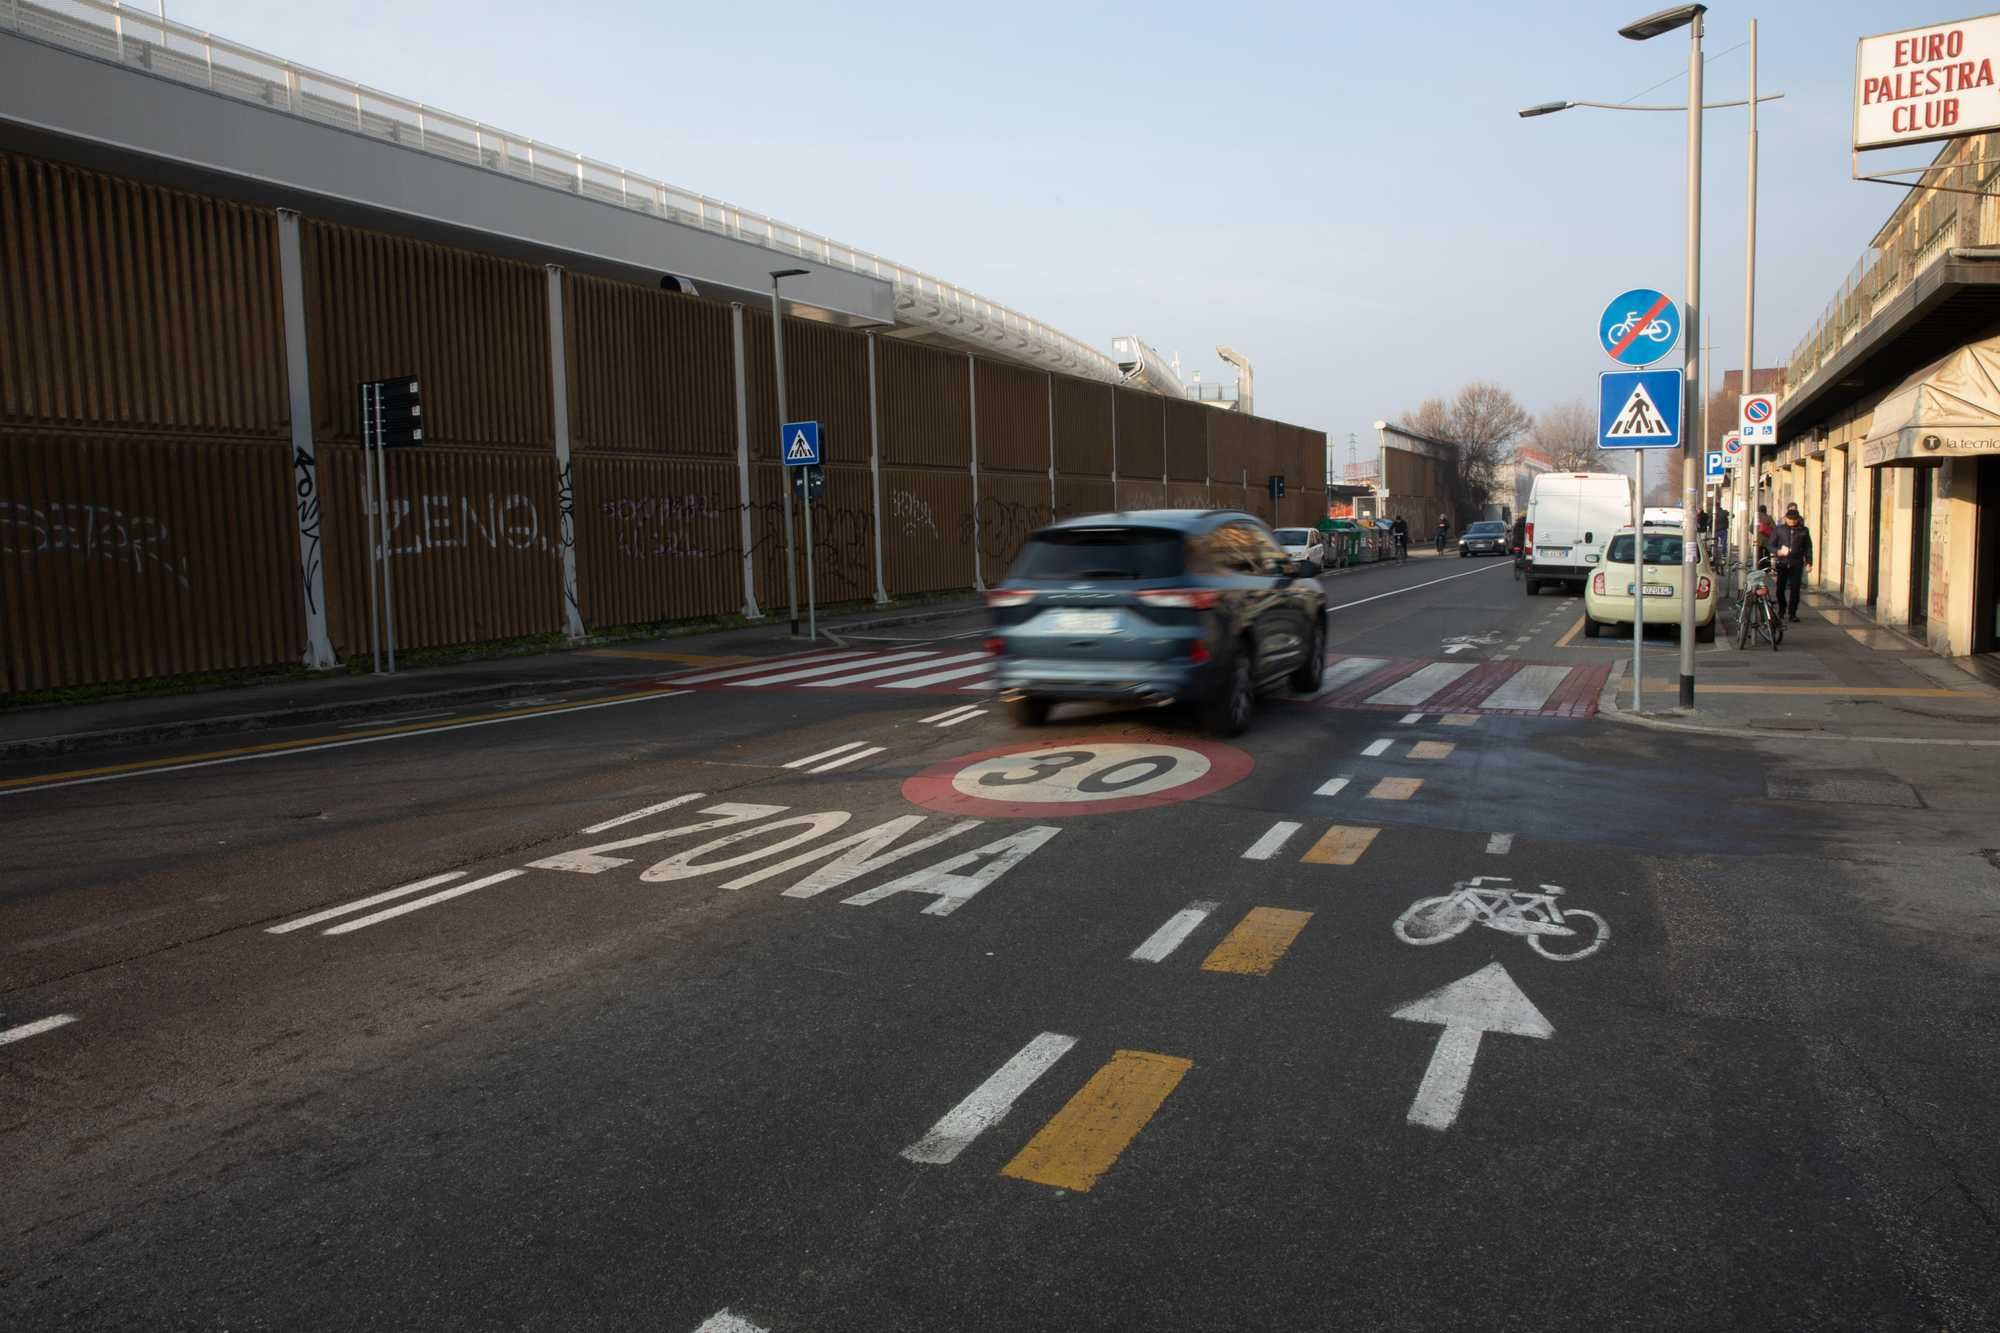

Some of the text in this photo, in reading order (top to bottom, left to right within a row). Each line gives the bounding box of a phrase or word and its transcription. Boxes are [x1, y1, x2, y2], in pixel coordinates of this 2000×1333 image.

[1893, 30, 1963, 68] EURO
[1862, 58, 1995, 106] PALESTRA
[1892, 97, 1960, 133] CLUB
[1709, 454, 1722, 474] P
[978, 751, 1178, 794] 30
[524, 803, 1064, 917] ZONA
